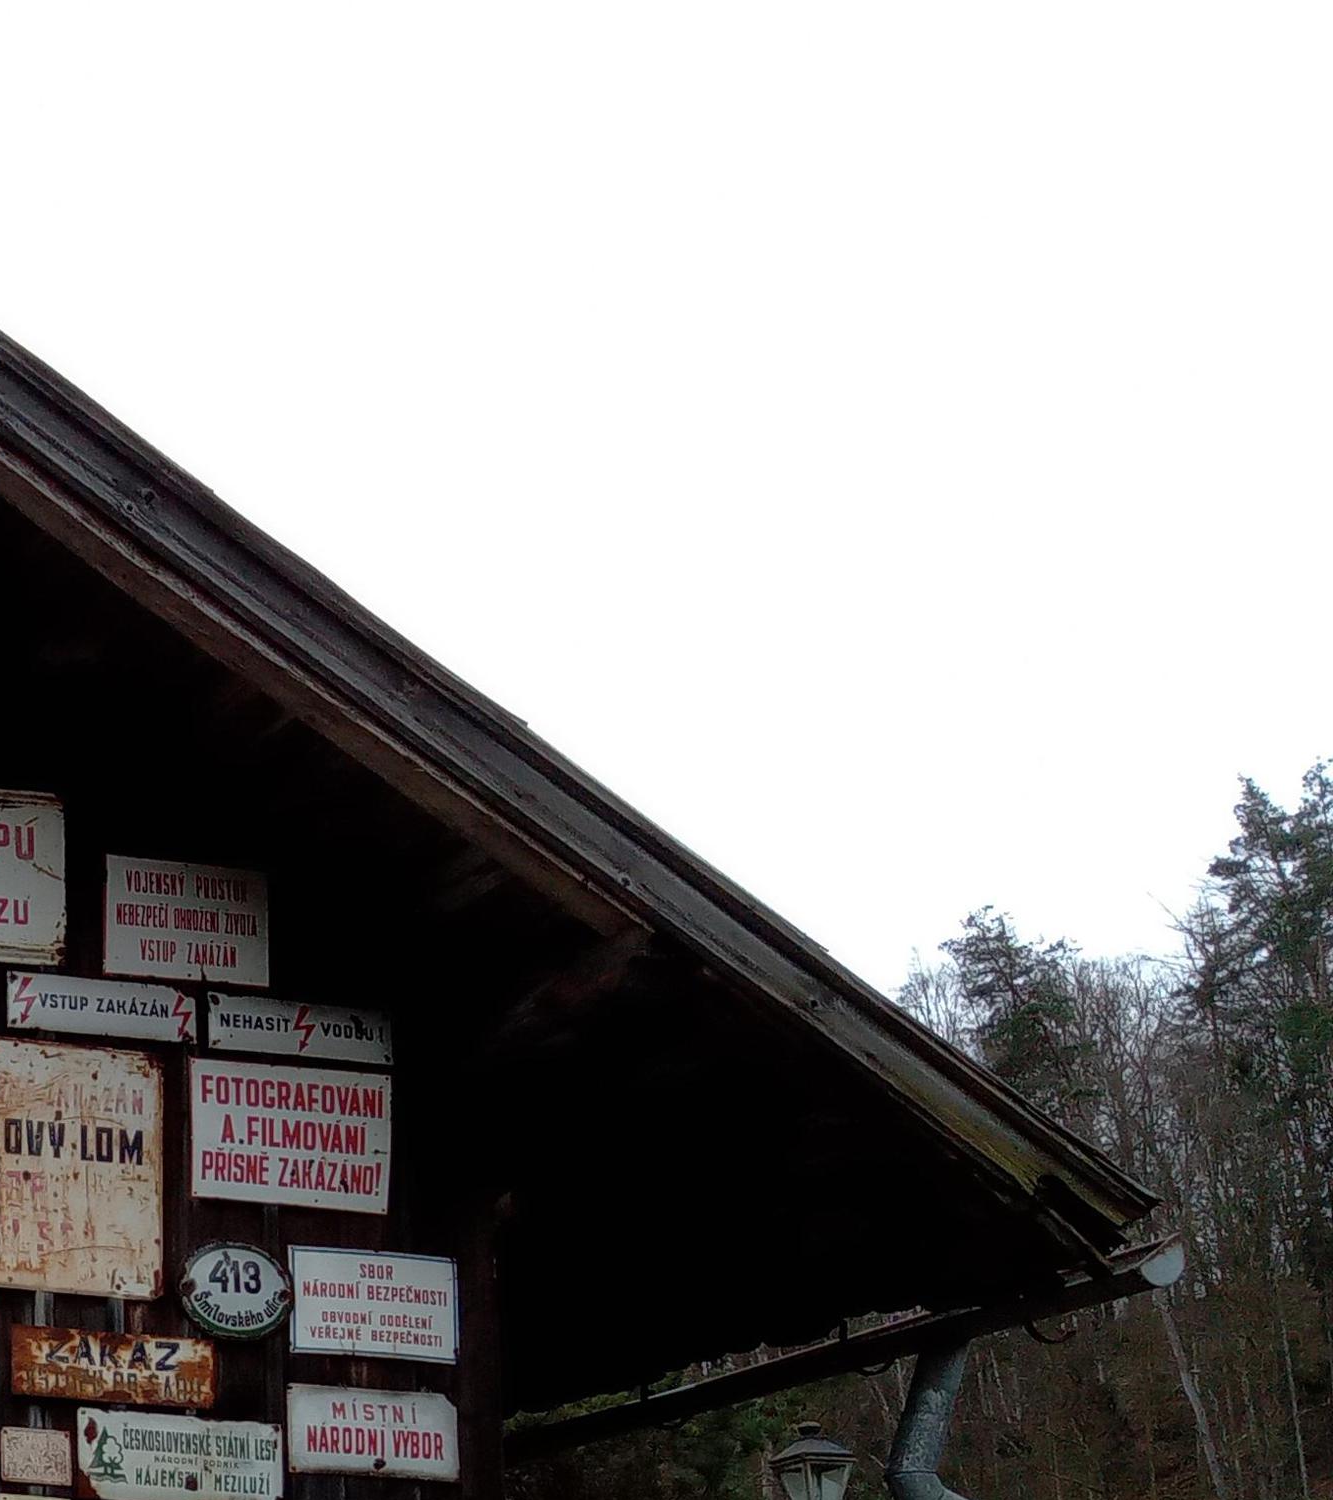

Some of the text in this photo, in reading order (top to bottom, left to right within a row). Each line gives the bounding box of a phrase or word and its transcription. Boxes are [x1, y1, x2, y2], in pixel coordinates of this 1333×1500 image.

[125, 868, 249, 903] VOJENSKÝ PROSTOR
[139, 939, 237, 968] VSTUP ZAKÁZÁN
[38, 991, 169, 1018] VSTUP ZAKÁZÁN
[200, 1073, 384, 1118] FOTOGRAFOVÁNÍ
[80, 1128, 145, 1166] LOM
[200, 1148, 382, 1197] PŘÍSNĚ ZAKÁZÁNO!
[209, 1259, 260, 1294] 413
[358, 1261, 394, 1281] SBOR
[303, 1276, 448, 1307] NÁRODNÍ BEZPEČNOSTI
[321, 1309, 432, 1329] OBVODNÍ ODDĚLENÍ
[309, 1323, 443, 1349] VEŘEJNÉ BEZPEČNOSTI
[332, 1400, 419, 1425] MÍSTNÍ
[123, 1423, 210, 1455] ČESKOSLOVENSKÉ
[216, 1430, 250, 1459] STÁTNÍ
[306, 1422, 445, 1462] NÁRODNÍ VÝBOR
